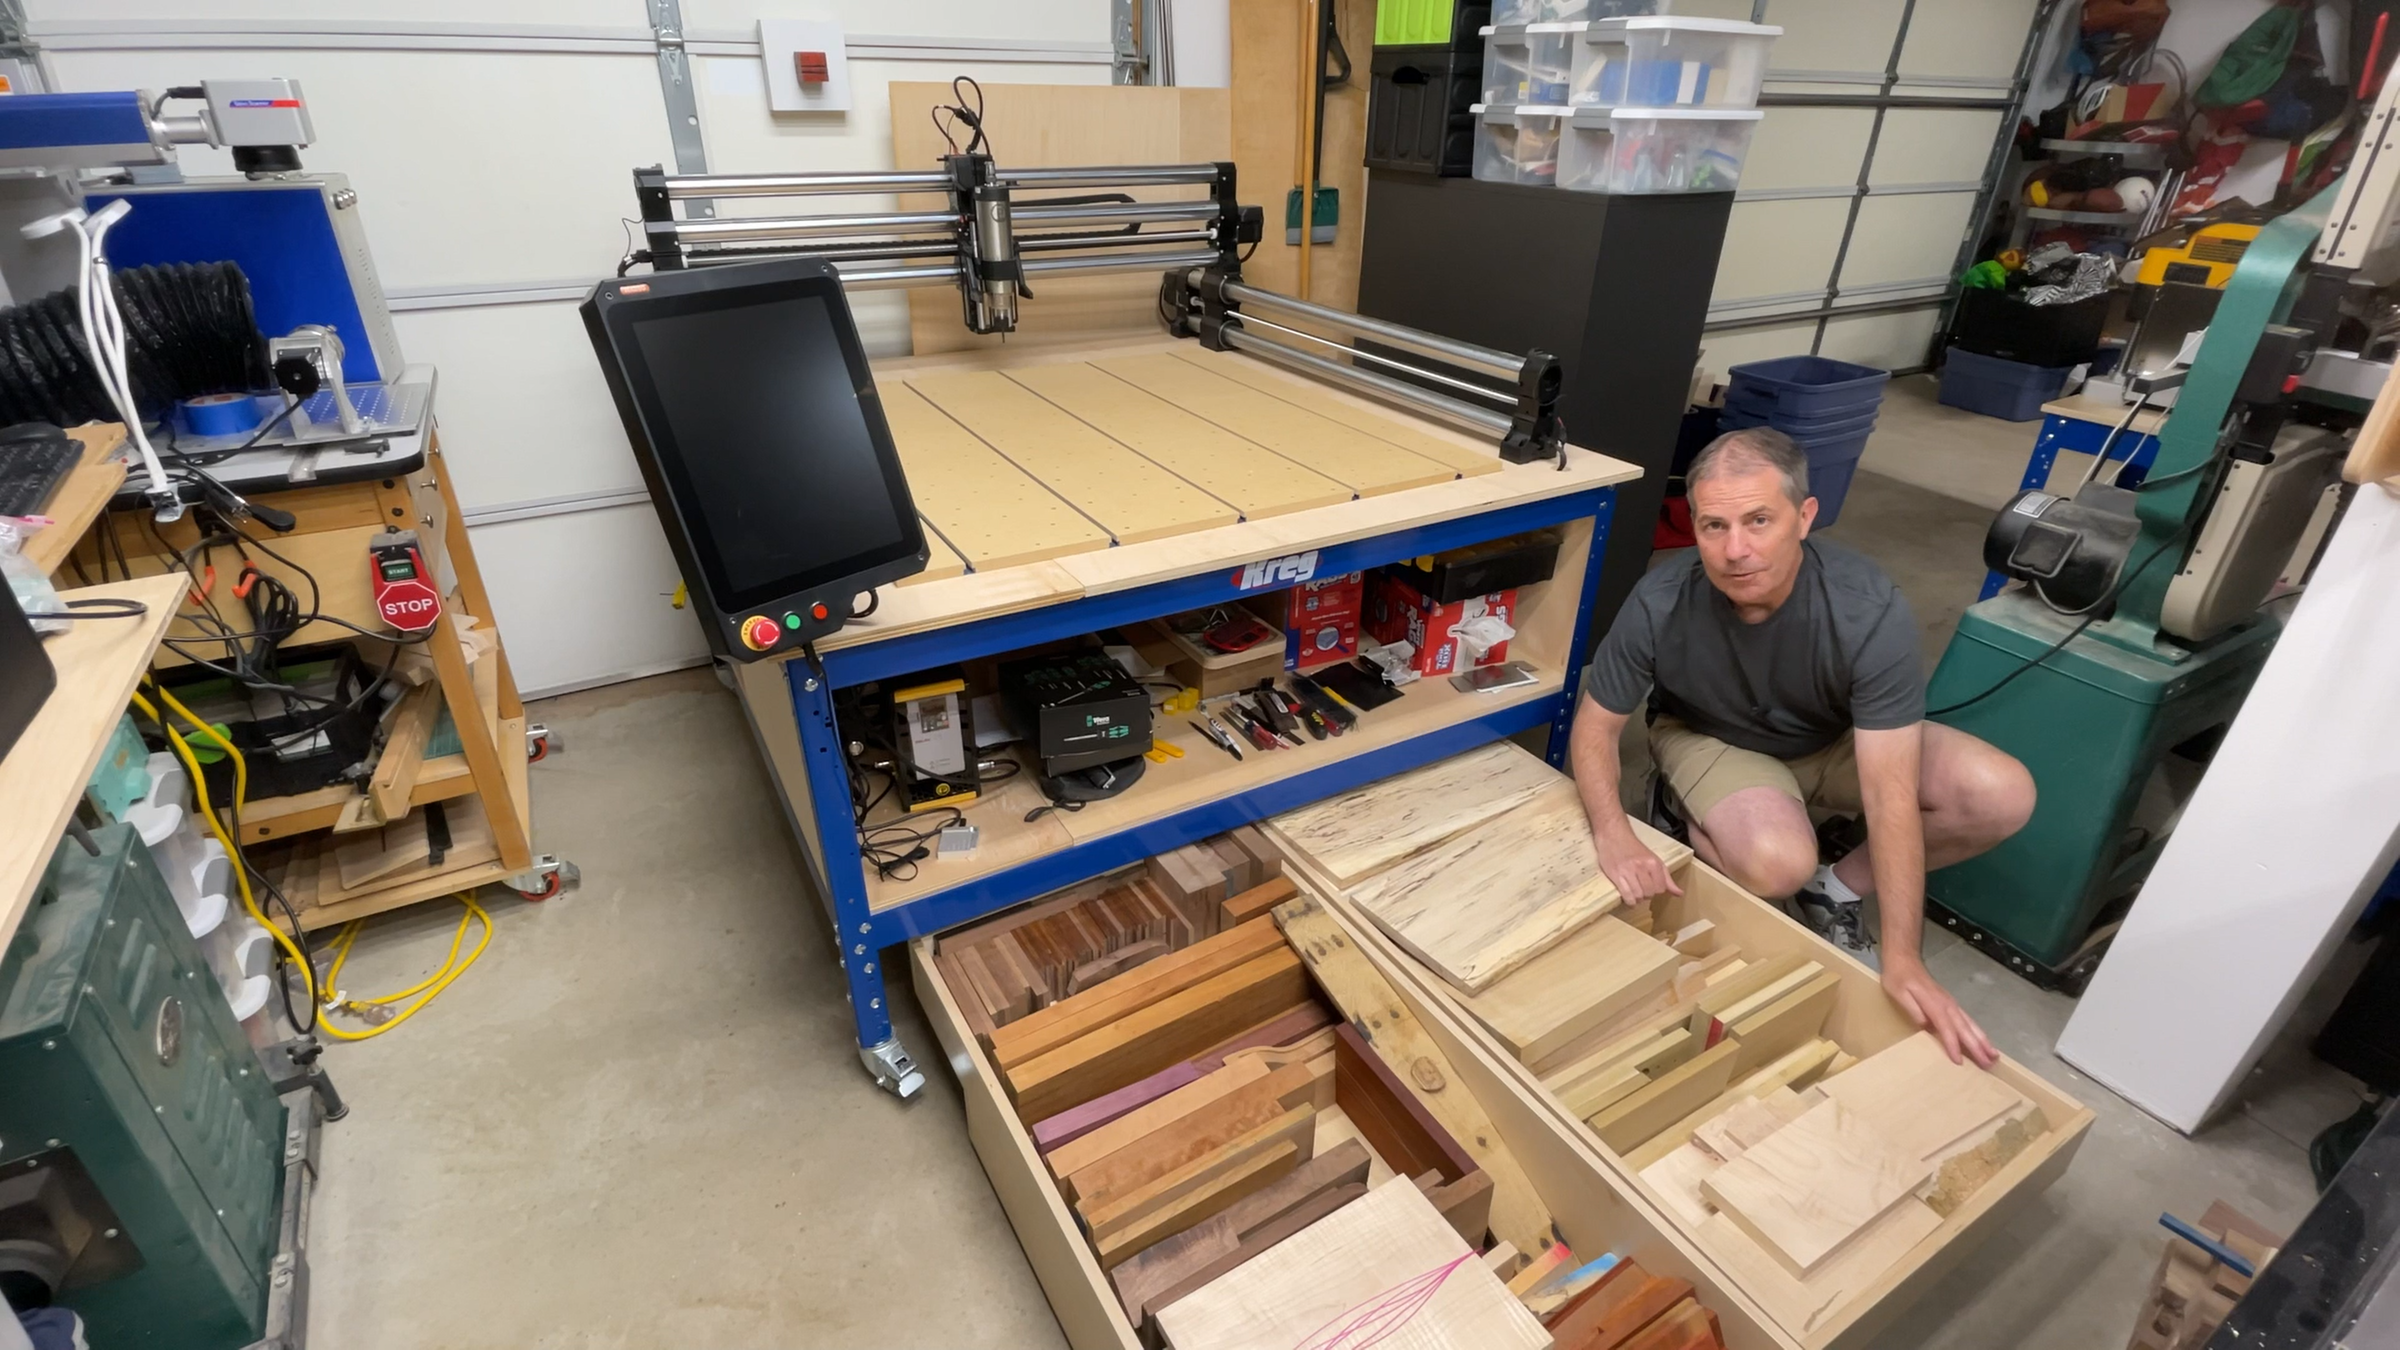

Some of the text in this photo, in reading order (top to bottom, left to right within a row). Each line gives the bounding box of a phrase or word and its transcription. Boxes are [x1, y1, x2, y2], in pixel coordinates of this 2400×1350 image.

[388, 567, 409, 575] START
[1240, 550, 1319, 591] Kreg
[385, 598, 433, 615] STOP
